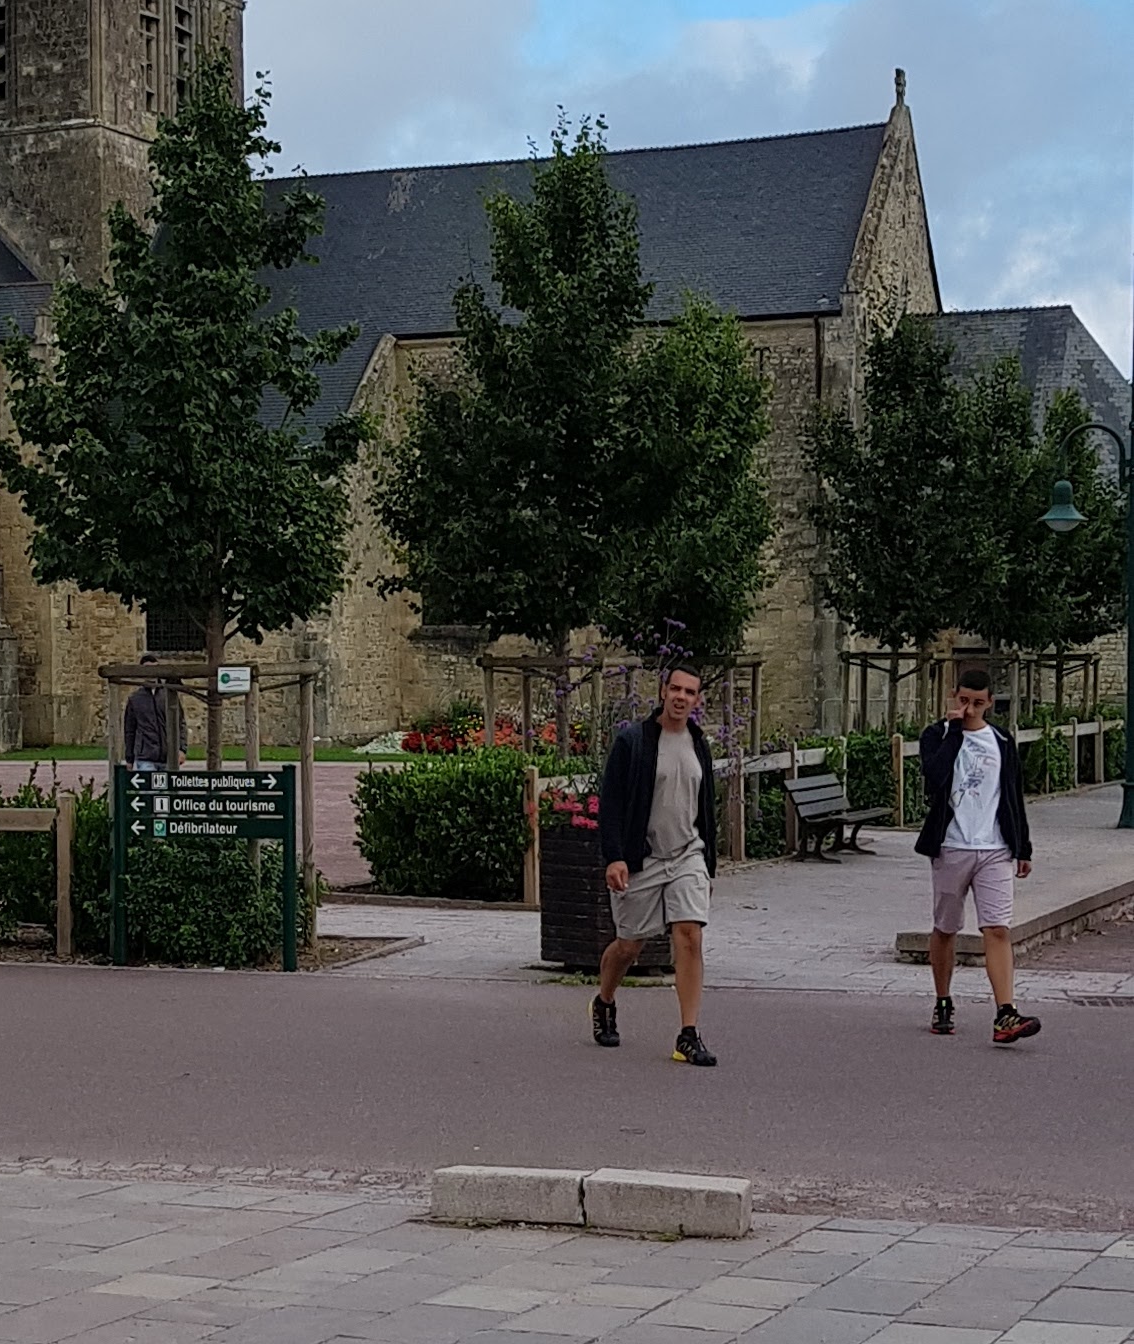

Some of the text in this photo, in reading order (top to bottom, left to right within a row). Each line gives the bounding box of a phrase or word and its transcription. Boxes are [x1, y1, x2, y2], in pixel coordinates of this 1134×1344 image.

[171, 776, 255, 790] Toilettes publiques
[173, 799, 276, 811] Office du tourisme
